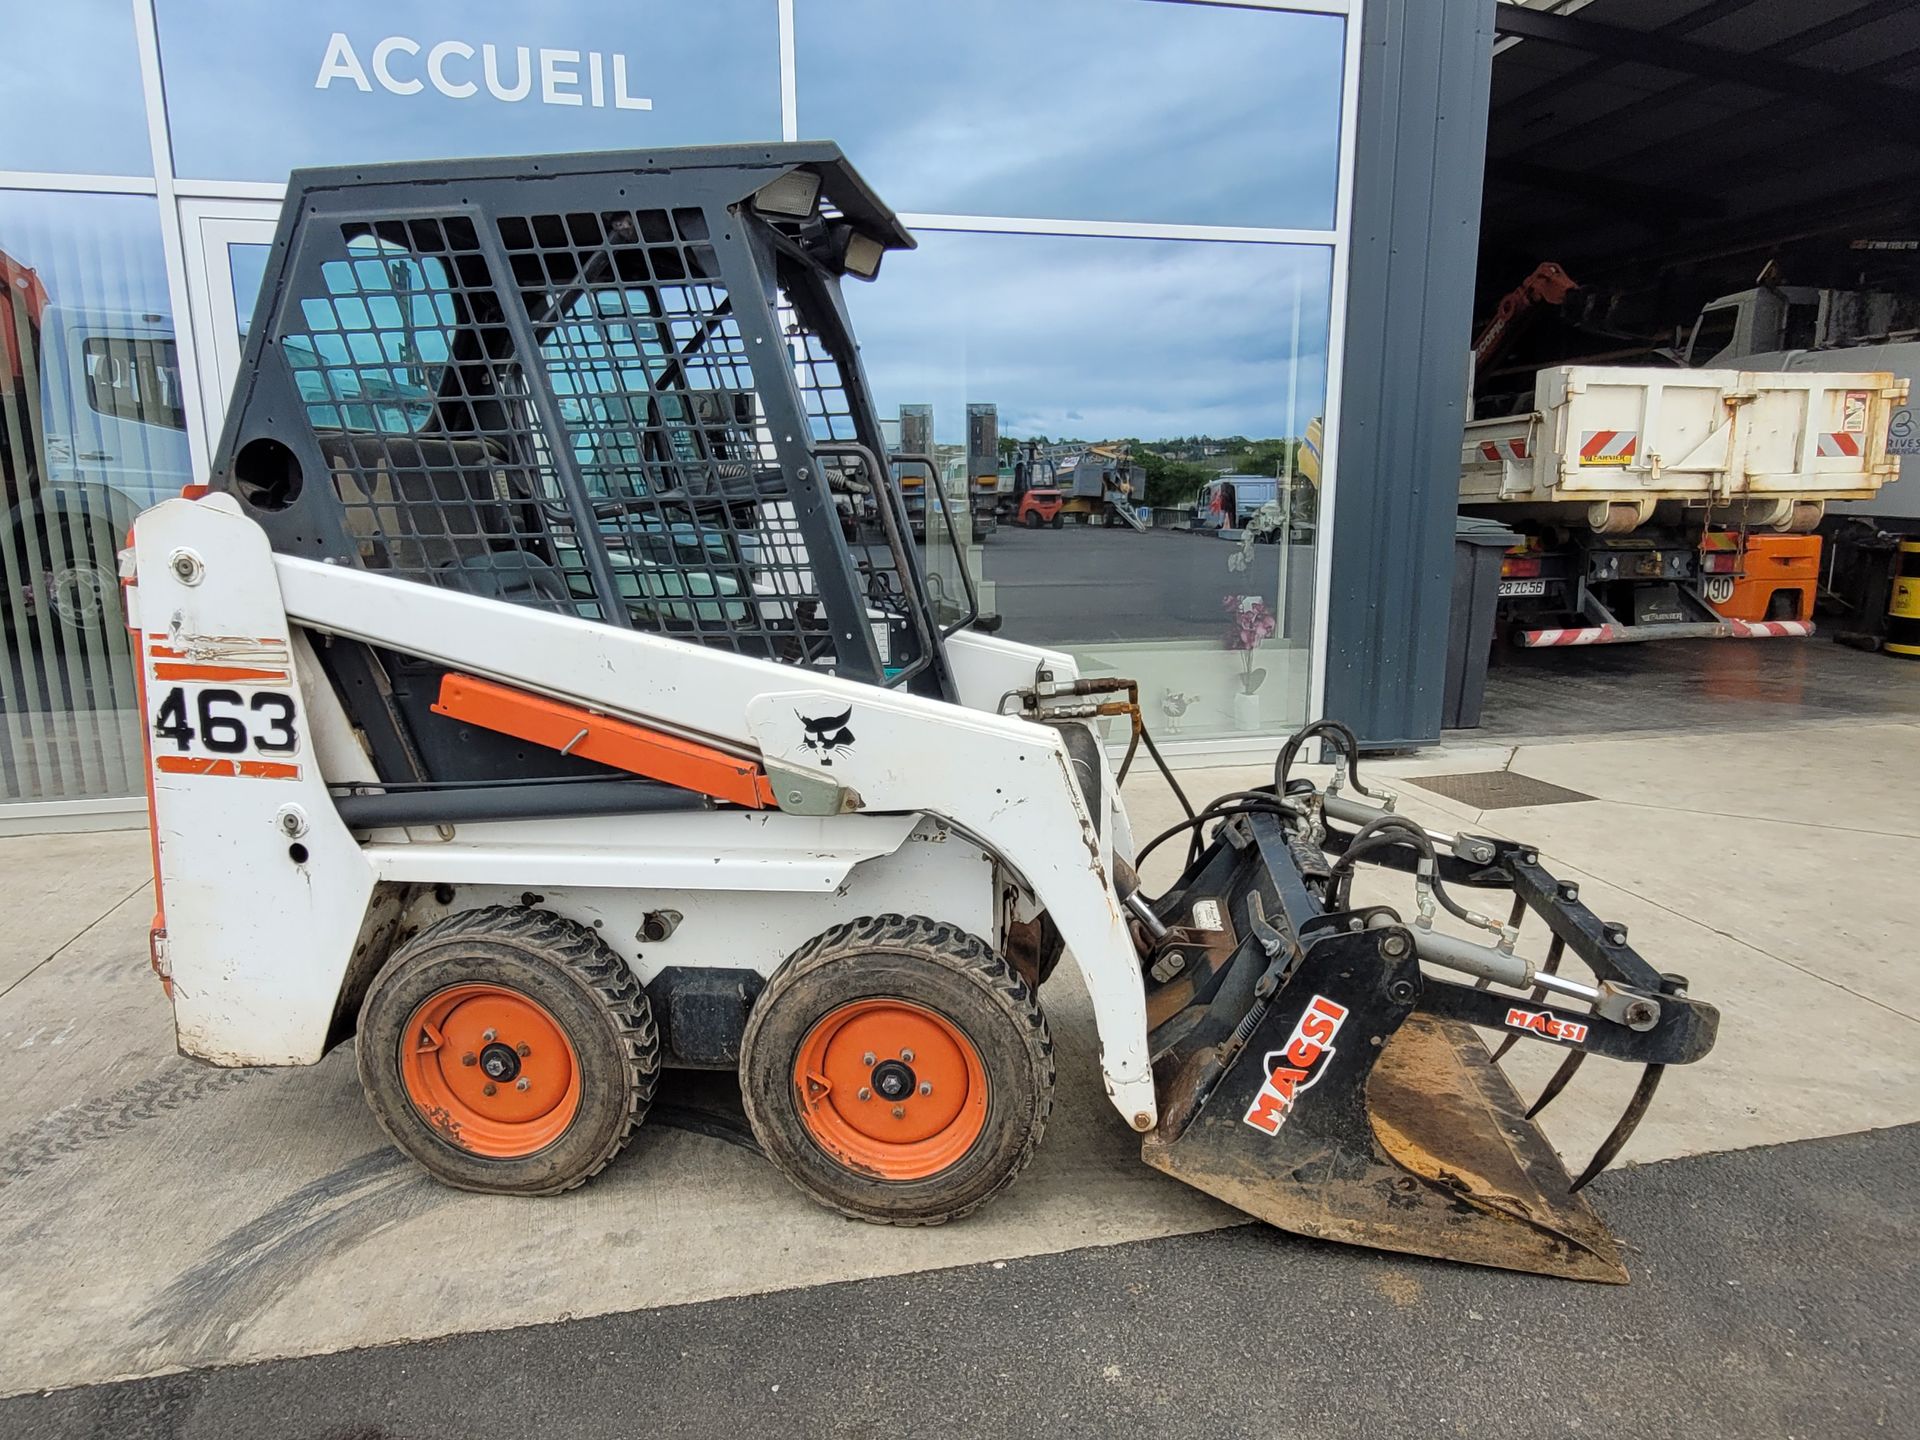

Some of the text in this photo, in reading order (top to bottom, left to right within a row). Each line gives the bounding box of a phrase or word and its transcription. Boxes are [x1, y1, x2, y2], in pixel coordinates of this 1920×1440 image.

[314, 32, 653, 111] ACCUEIL
[1514, 582, 1527, 594] ZC
[1529, 581, 1543, 594] 56
[1712, 578, 1730, 600] 90
[155, 687, 297, 753] 463
[1507, 1010, 1586, 1041] MAGSI
[1247, 998, 1345, 1133] MAGSI
